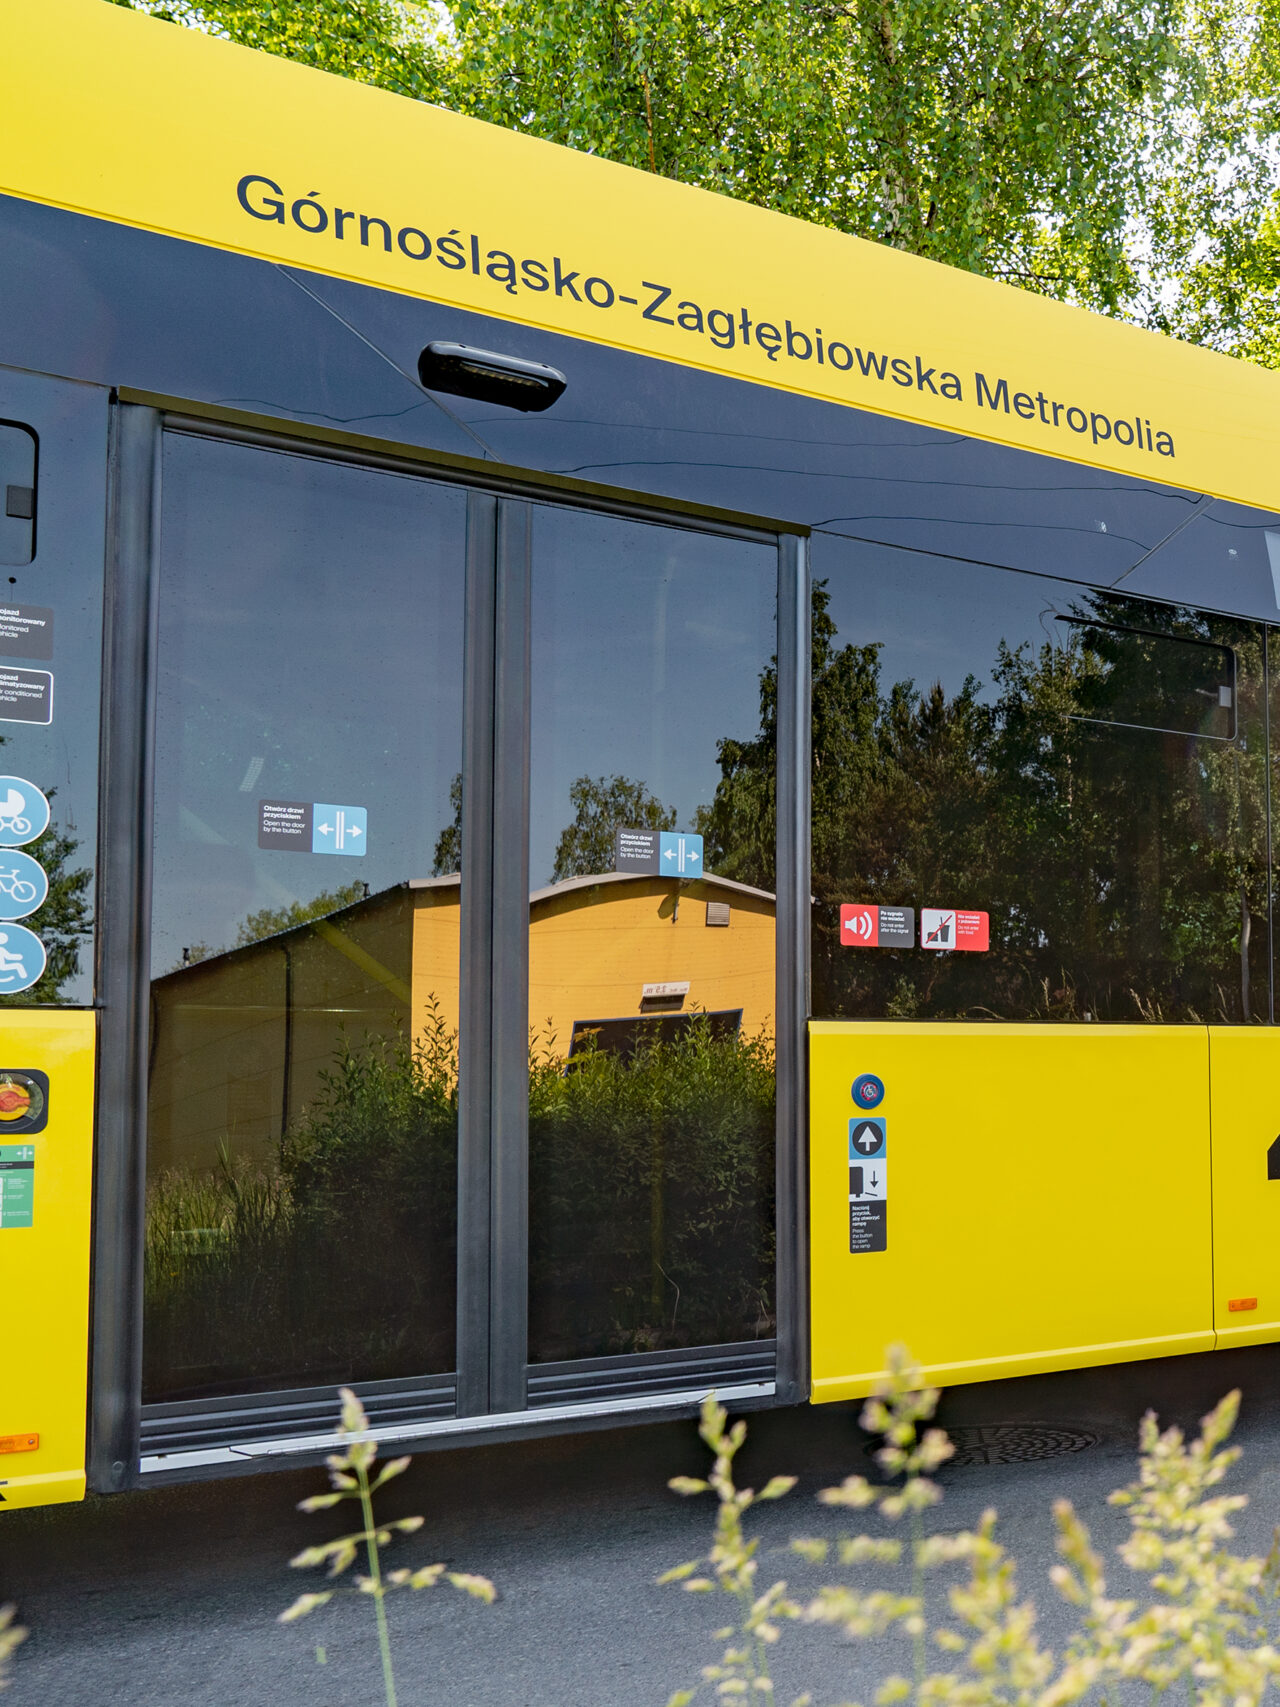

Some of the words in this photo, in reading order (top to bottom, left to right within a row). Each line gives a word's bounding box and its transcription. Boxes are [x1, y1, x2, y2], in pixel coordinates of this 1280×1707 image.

[237, 175, 962, 402] Górnośląsko-Zagłębiowska
[976, 373, 1175, 458] Metropolia
[0, 616, 46, 627] onitorowany
[0, 624, 29, 632] onitored
[4, 690, 42, 698] conditioned
[263, 805, 286, 813] Otwórz
[287, 806, 304, 814] drzwi
[263, 812, 301, 820] przyciskiem
